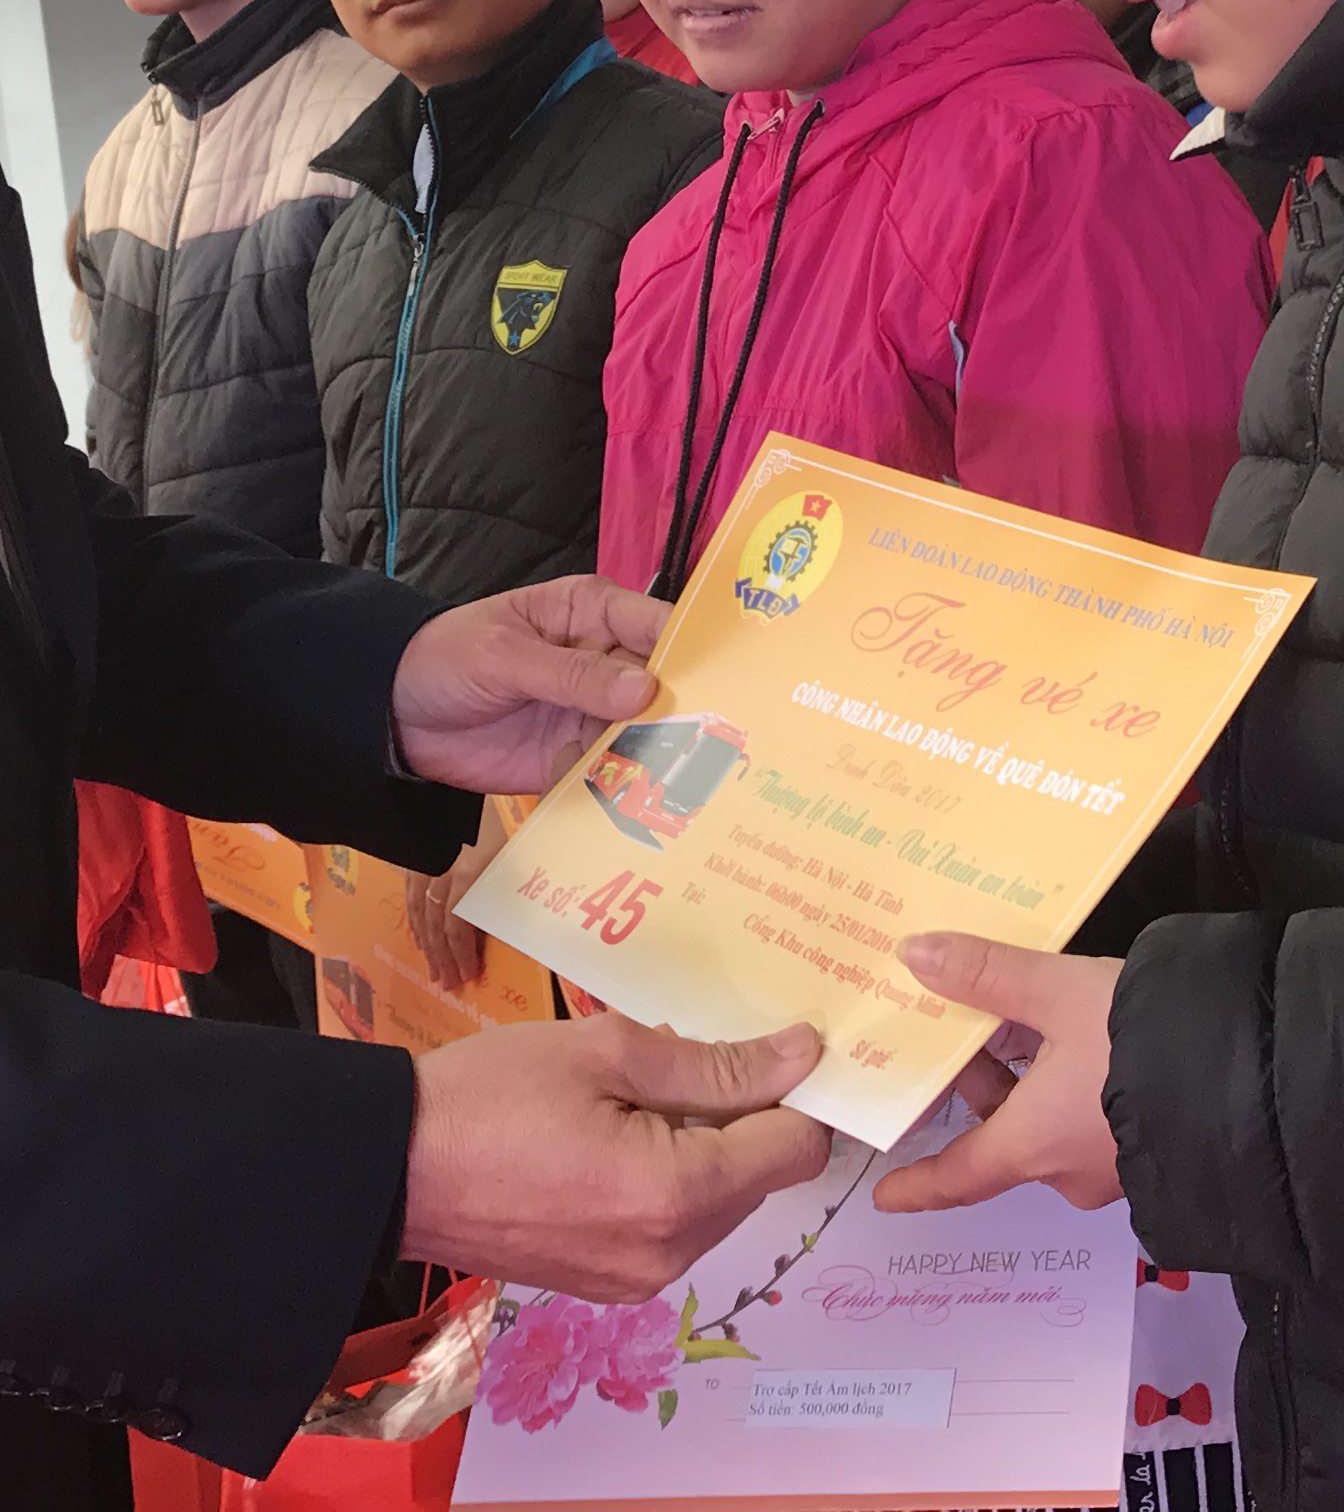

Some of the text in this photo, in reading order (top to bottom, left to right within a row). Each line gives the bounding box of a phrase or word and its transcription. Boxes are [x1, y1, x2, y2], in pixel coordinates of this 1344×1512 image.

[867, 527, 1235, 650] LIÊN ĐOÀN LAO ĐỘNG THÀNH PHỐ HÀ NỘI
[850, 591, 1161, 738] Tặng vé xe
[791, 679, 1127, 816] CÔNG NHÂN LAO ĐỘNG VỀ QUÊ ĐÓN TẾT
[802, 857, 824, 879] Hà
[822, 866, 850, 890] Nội
[852, 879, 875, 903] Hà
[516, 866, 550, 901] Xe
[578, 869, 666, 946] 45
[774, 928, 804, 956] Khu
[802, 946, 835, 975] công
[887, 1248, 1092, 1276] HAPPY NEW YEAR
[955, 1285, 1010, 1306] năm
[748, 1401, 766, 1417] Số
[798, 1402, 850, 1418] 500,000
[851, 1400, 885, 1419] đồng
[754, 1379, 913, 1399] Trợ cấp Tết Âm lịch 2017
